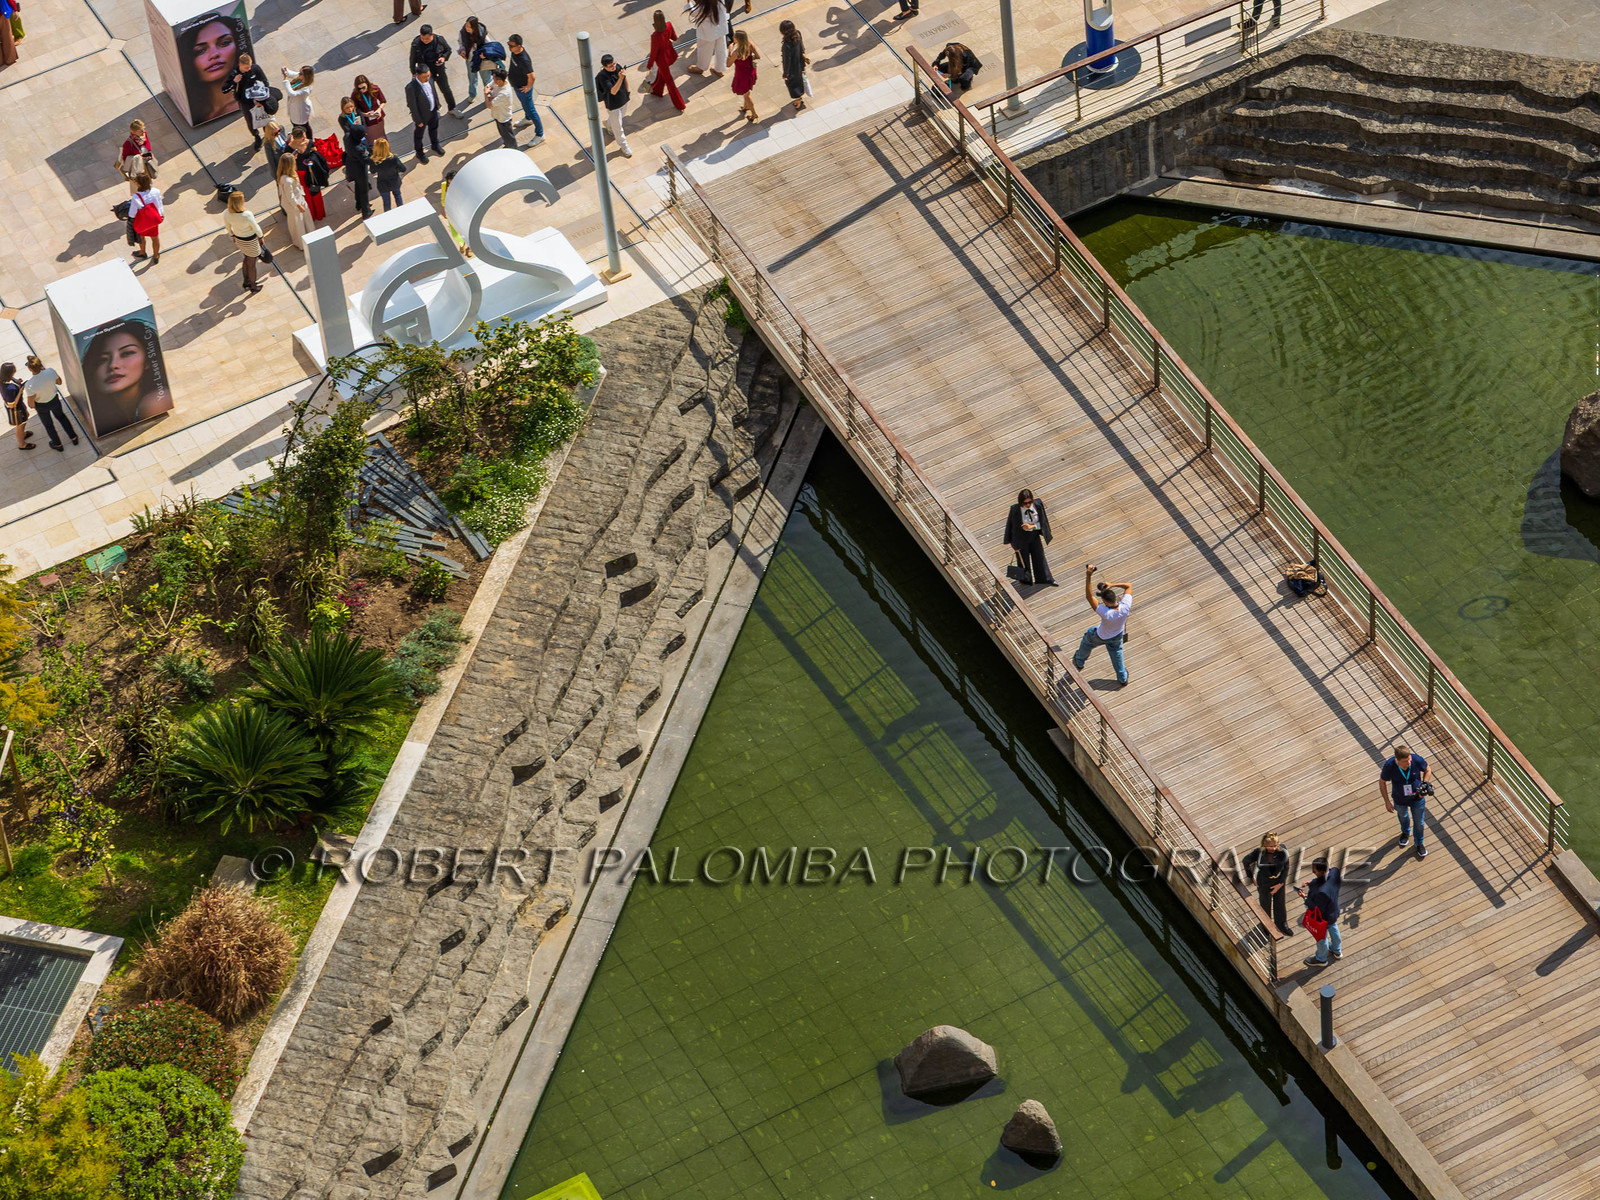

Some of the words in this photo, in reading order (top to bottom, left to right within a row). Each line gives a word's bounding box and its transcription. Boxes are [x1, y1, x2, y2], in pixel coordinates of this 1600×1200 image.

[239, 30, 247, 50] Skin
[147, 340, 157, 359] Skin
[152, 358, 162, 380] Laser
[157, 379, 167, 402] Your
